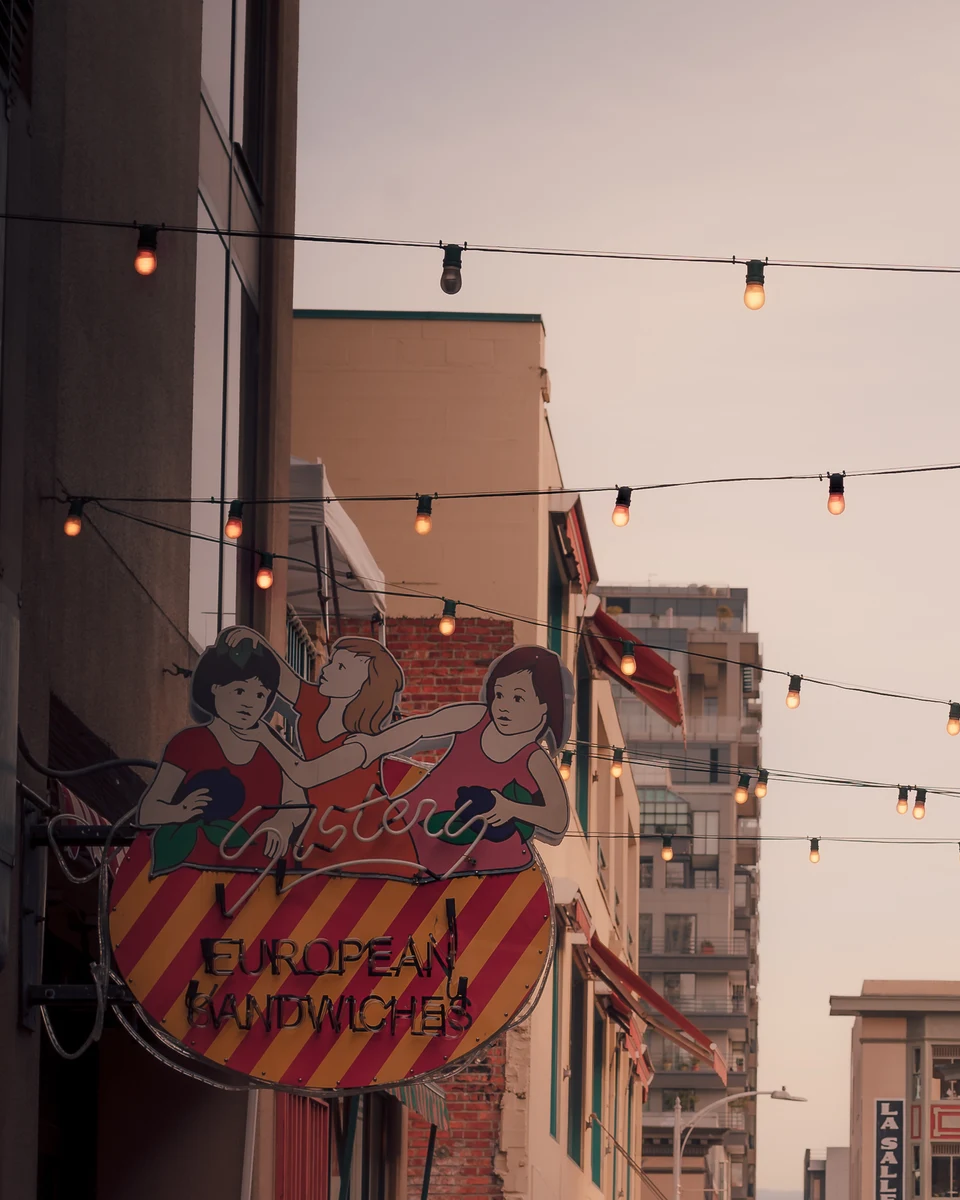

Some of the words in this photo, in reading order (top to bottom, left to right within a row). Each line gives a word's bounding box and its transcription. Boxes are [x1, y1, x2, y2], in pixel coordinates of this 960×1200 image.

[202, 934, 454, 978] EUROPEAN
[186, 990, 474, 1040] SANDWICHES
[880, 1102, 899, 1130] LA
